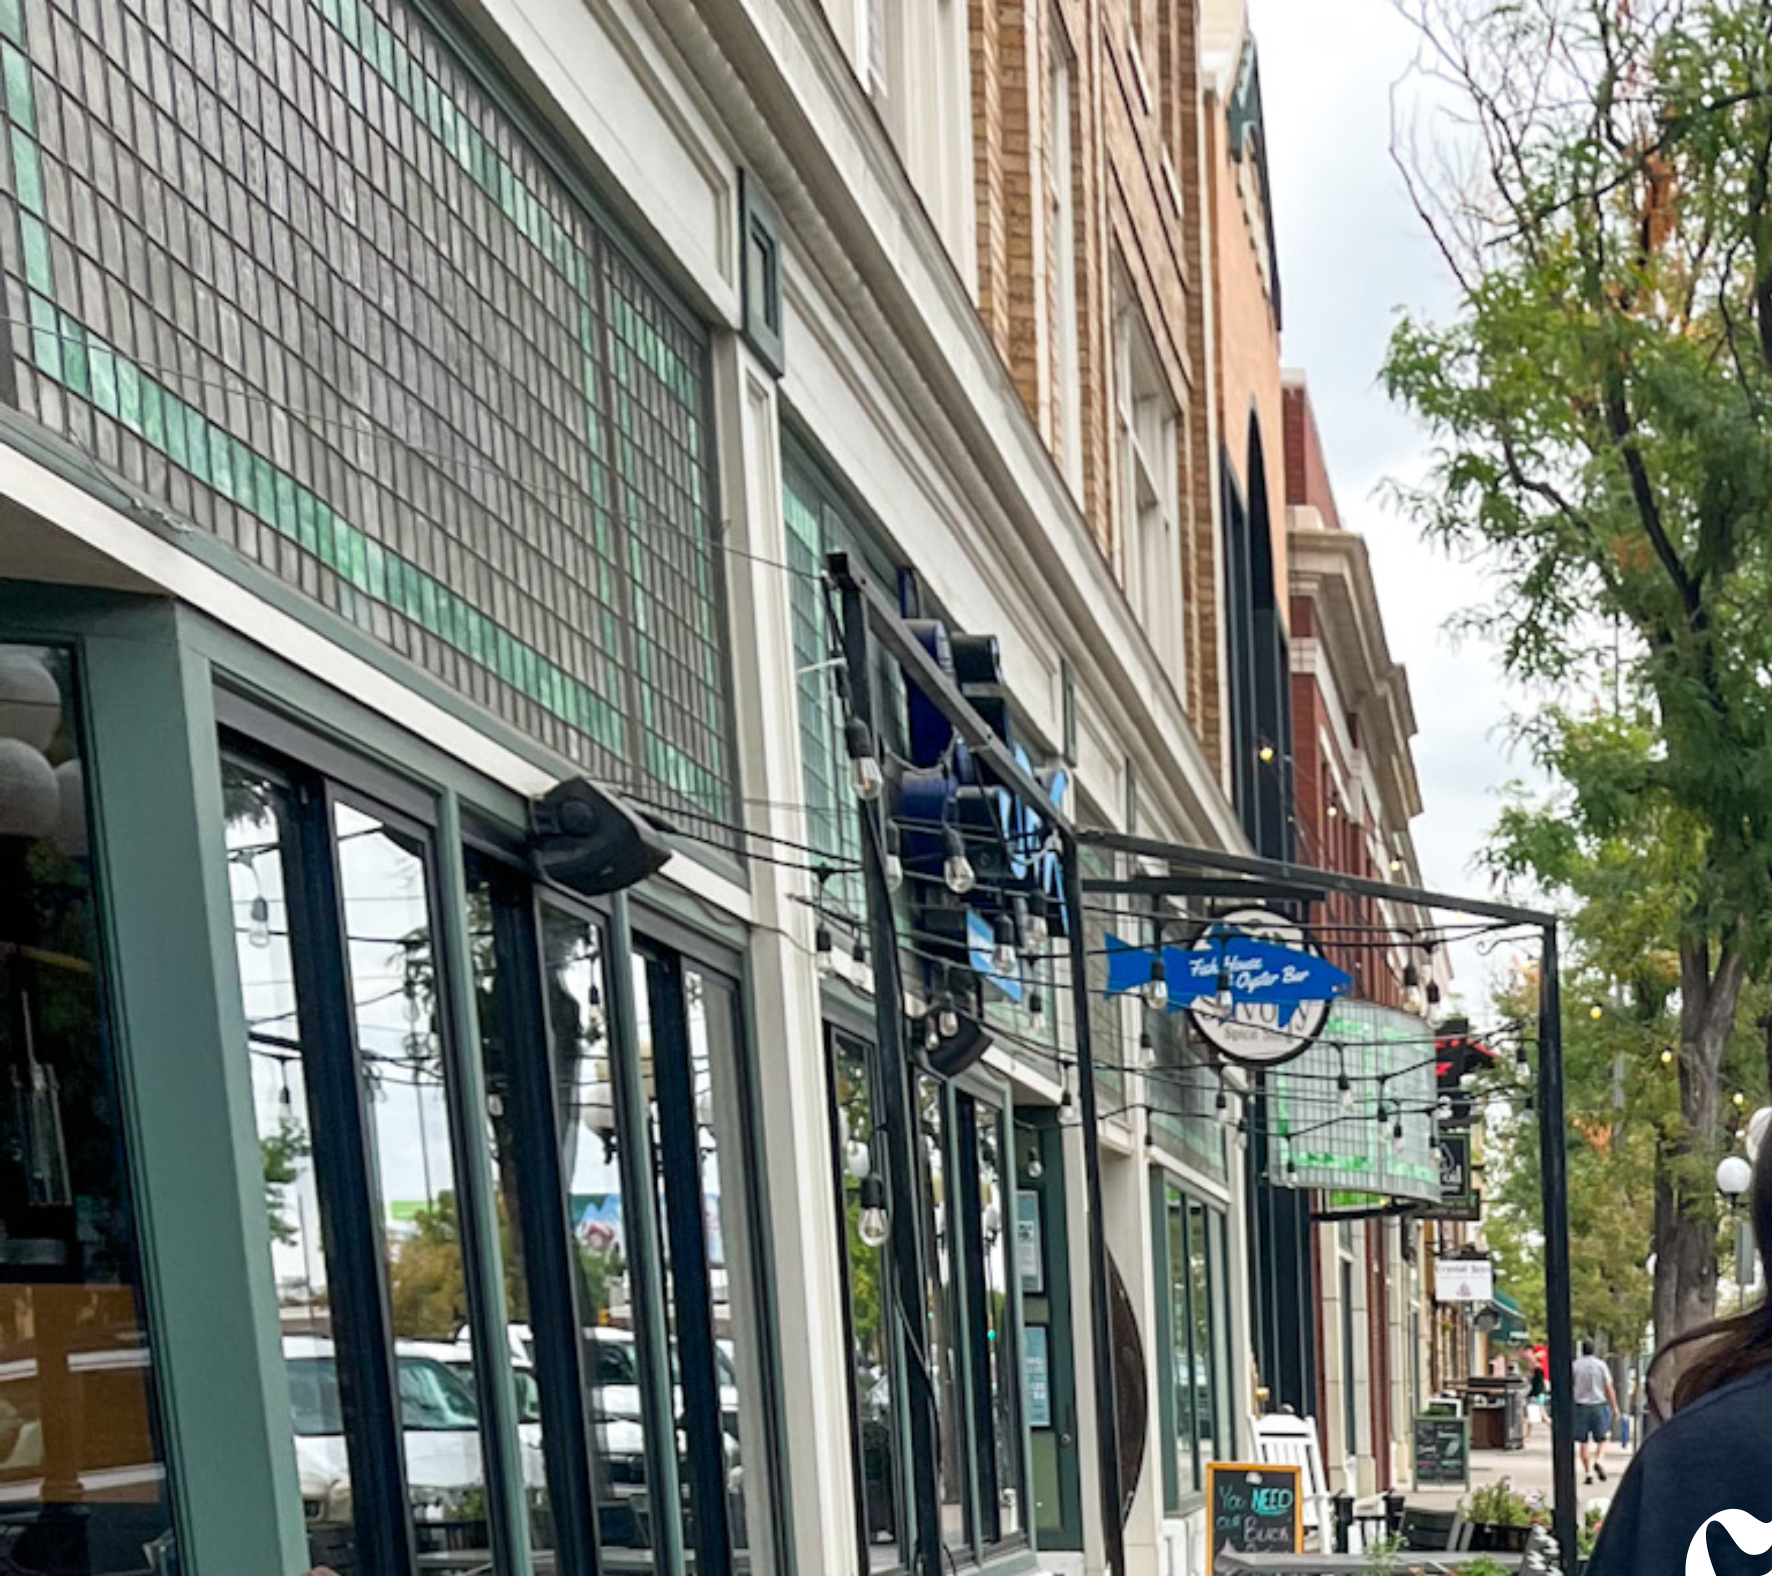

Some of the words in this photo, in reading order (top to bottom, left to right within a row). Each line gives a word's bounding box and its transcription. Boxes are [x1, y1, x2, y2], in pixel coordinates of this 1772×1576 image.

[1224, 955, 1263, 971] House
[1237, 971, 1279, 993] Oyster
[1281, 964, 1310, 984] Bar
[1251, 1488, 1294, 1511] NEED
